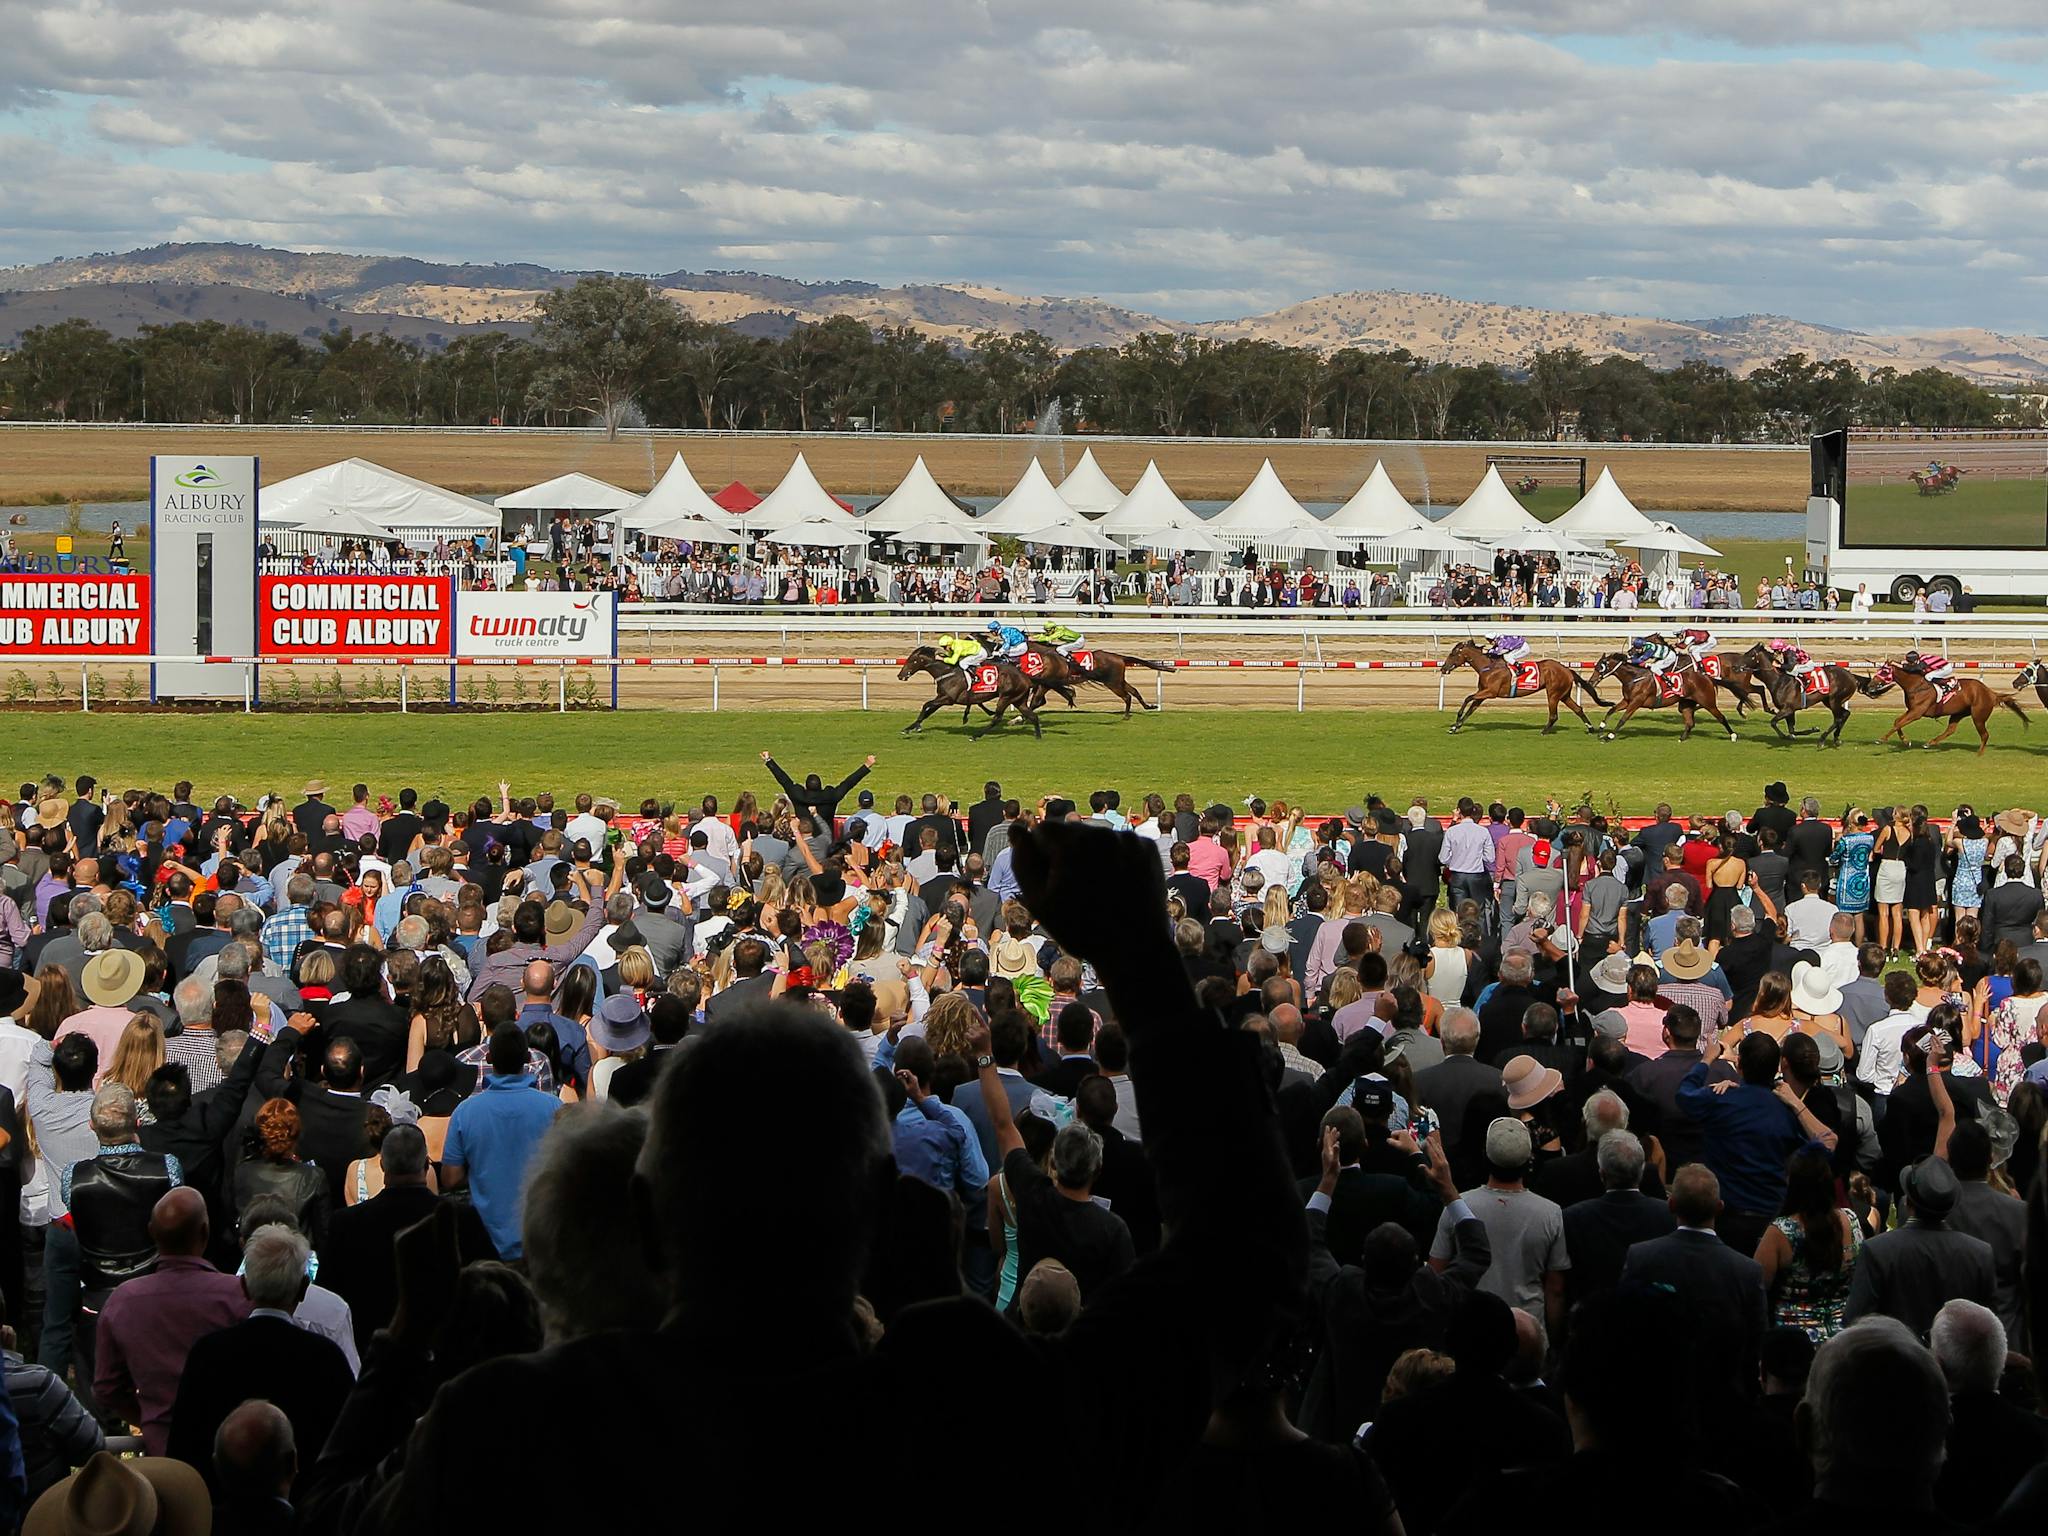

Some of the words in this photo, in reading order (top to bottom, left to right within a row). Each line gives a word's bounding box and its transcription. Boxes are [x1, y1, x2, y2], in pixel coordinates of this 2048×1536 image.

[164, 494, 246, 510] ALBURY
[164, 514, 211, 523] RACING
[214, 514, 244, 523] CLUB
[2, 582, 140, 610] MMERCIAL
[271, 583, 440, 611] COMMERCIAL
[0, 618, 34, 645] UB
[42, 618, 141, 645] ALBURY
[273, 618, 338, 645] CLUB
[345, 618, 441, 645] ALBURY
[470, 615, 588, 642] twincity
[495, 637, 523, 647] truck
[525, 638, 560, 647] centre
[1028, 653, 1040, 669] 5
[1080, 654, 1092, 671] 4
[1706, 661, 1718, 677] 3
[983, 668, 995, 685] 6
[1525, 666, 1537, 683] 2
[1811, 670, 1829, 688] 11
